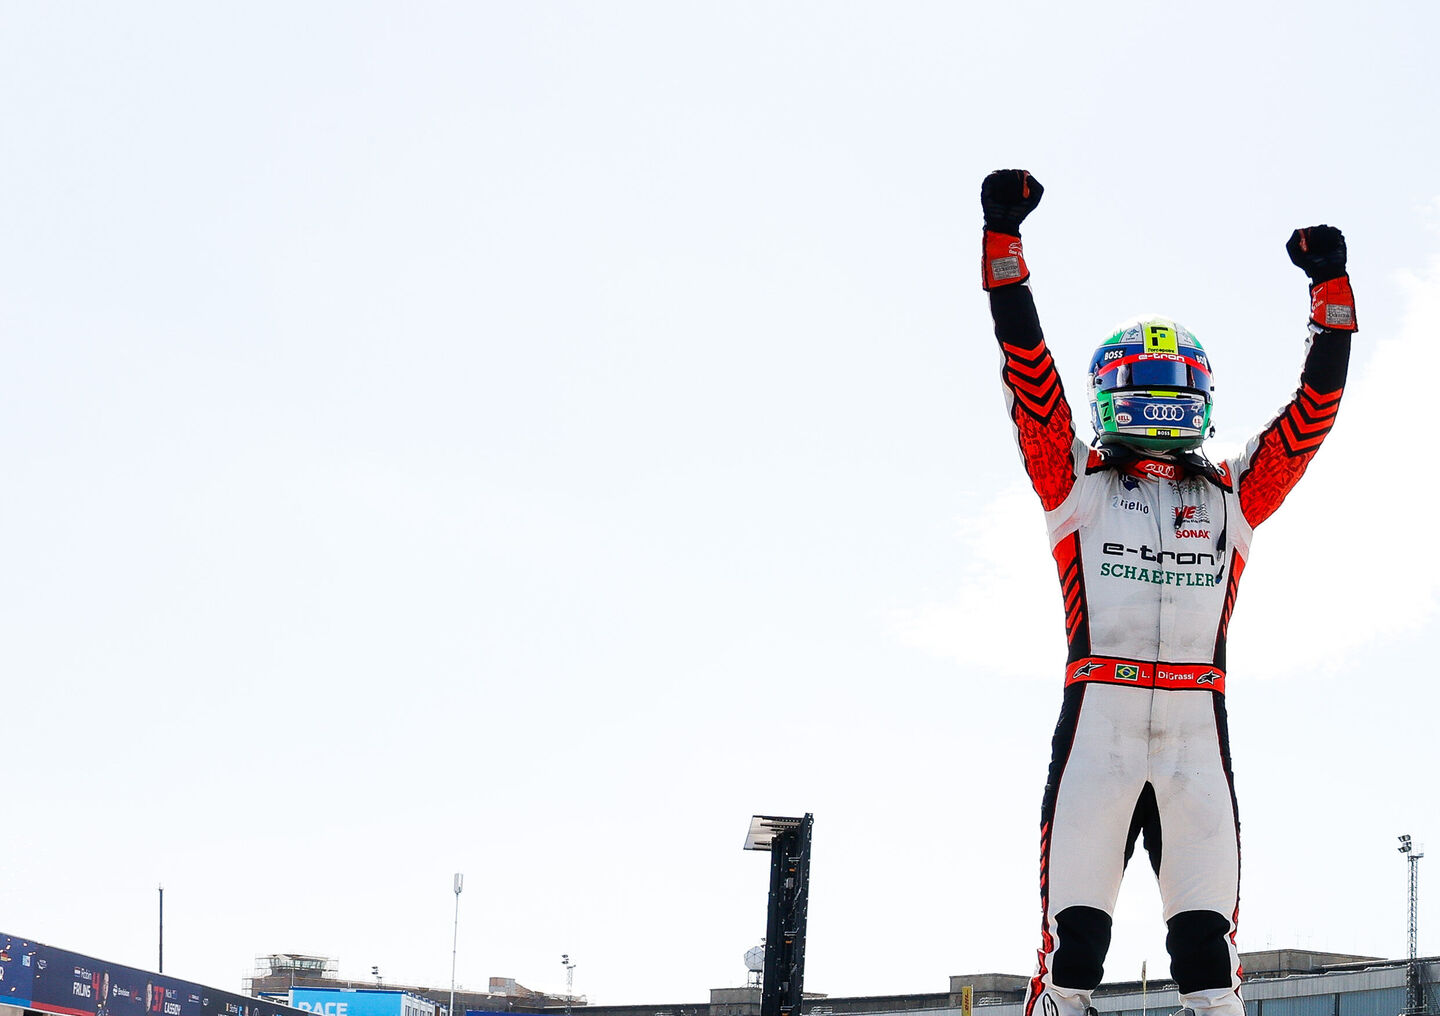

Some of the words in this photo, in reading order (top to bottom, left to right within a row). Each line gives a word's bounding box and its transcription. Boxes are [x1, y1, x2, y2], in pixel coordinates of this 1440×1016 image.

[1104, 349, 1124, 361] BOSS
[1138, 353, 1186, 363] e-tron
[1119, 499, 1150, 515] riello
[1175, 529, 1211, 540] SONAX
[1102, 542, 1216, 566] e-tron
[1100, 562, 1216, 588] SCHAEFFLER
[152, 985, 165, 1012] 37
